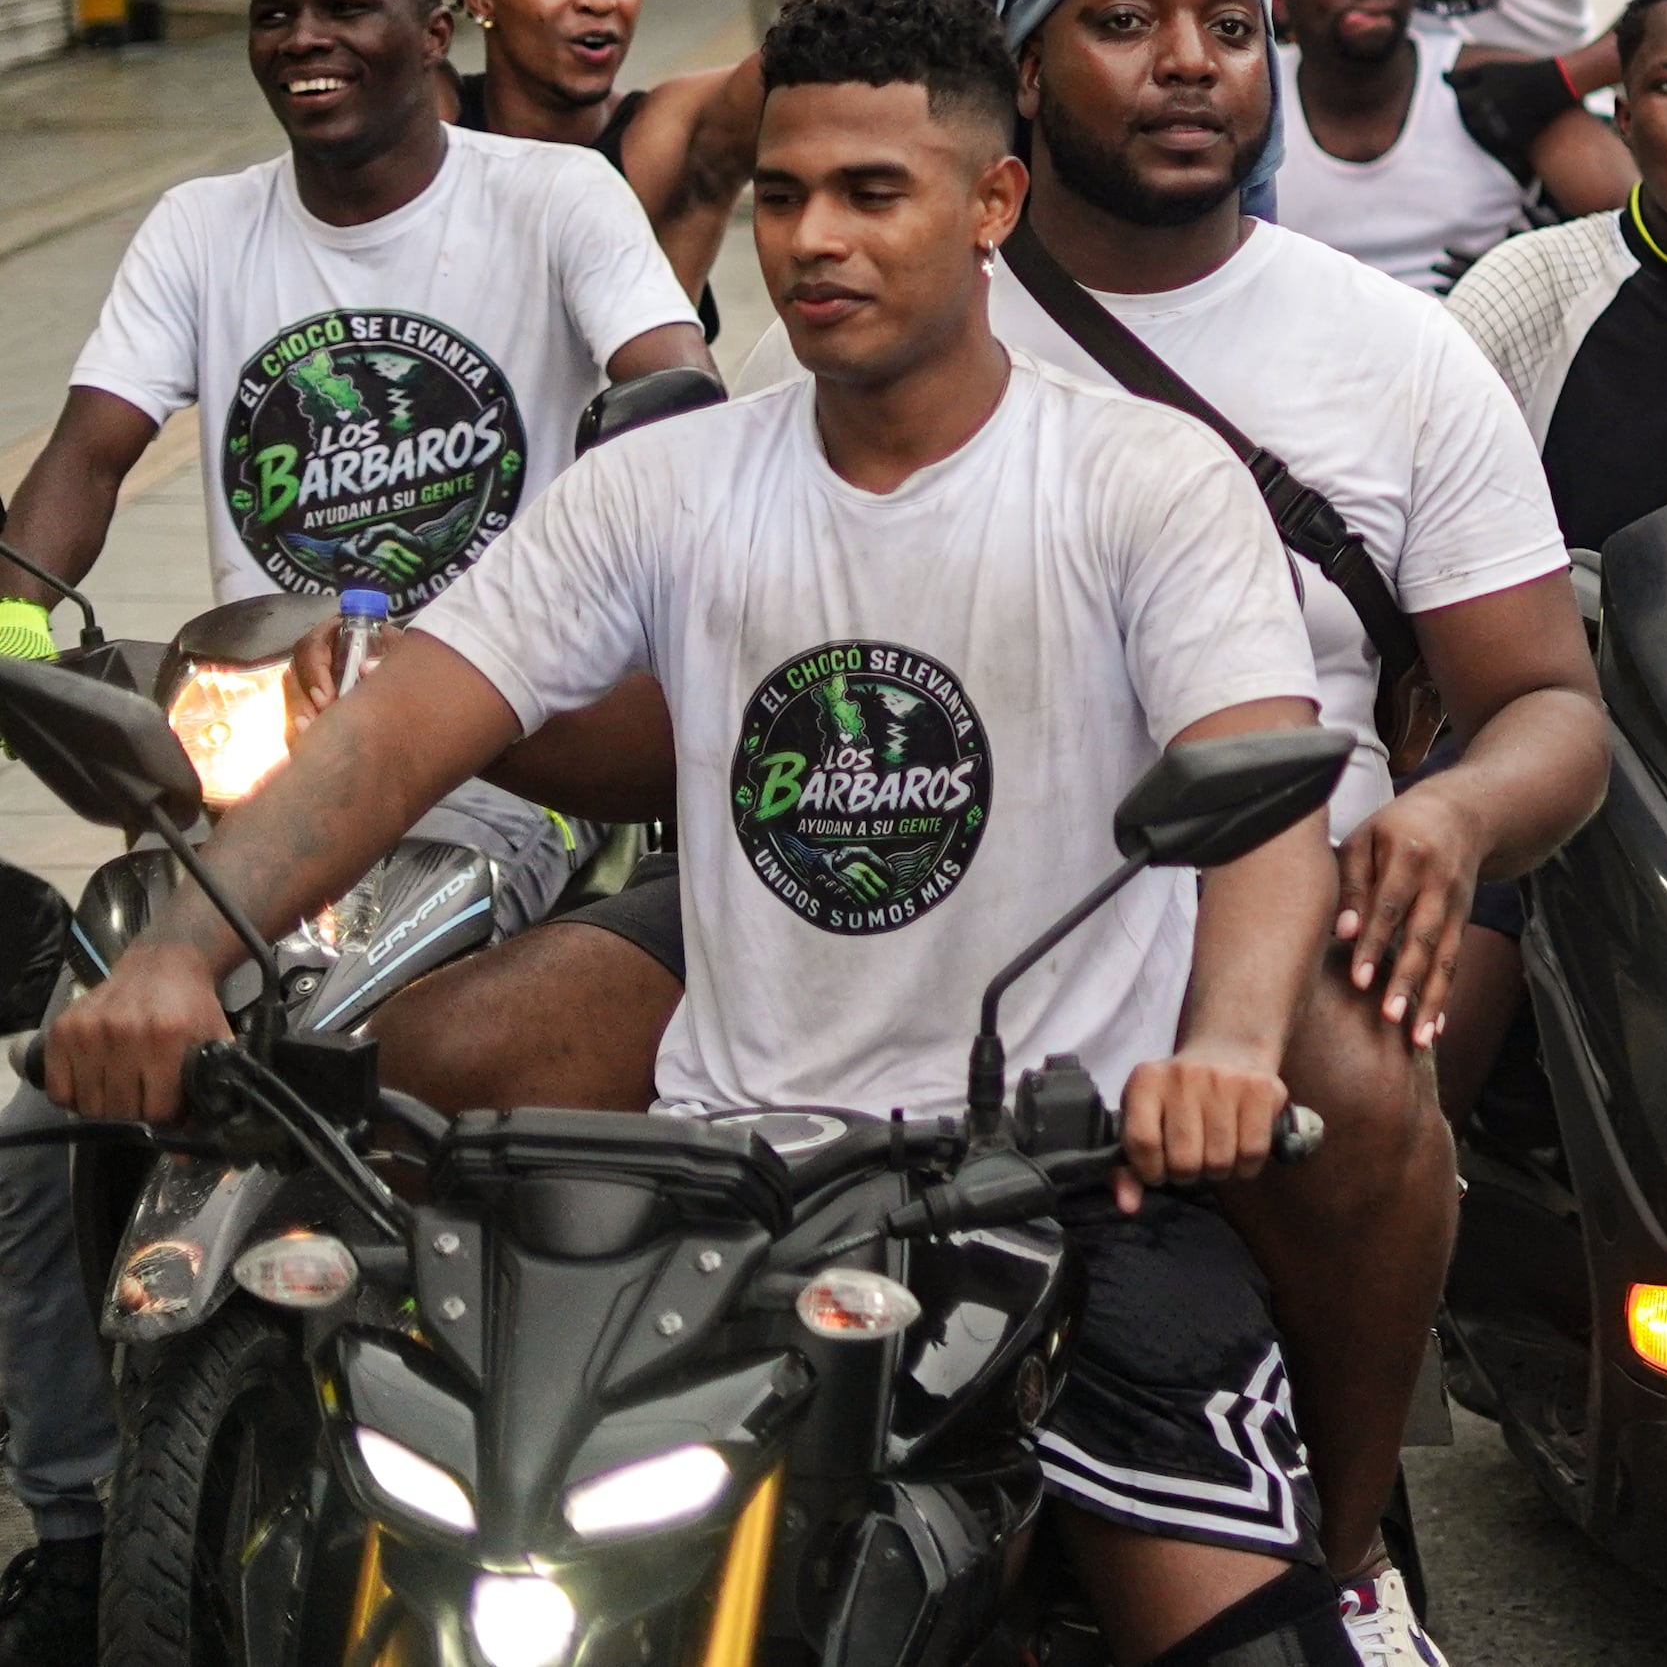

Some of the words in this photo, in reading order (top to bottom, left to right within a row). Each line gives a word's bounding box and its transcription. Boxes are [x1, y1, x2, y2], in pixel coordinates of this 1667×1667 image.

[239, 377, 267, 409] EL
[260, 314, 345, 378] CHOCÓ
[351, 316, 383, 341] SE
[390, 317, 490, 388] LEVANTA
[255, 406, 501, 525] BÁRBAROS
[318, 417, 380, 456] LOS
[303, 500, 372, 530] AYUDAN
[376, 495, 389, 513] A
[392, 489, 416, 510] SU
[419, 472, 476, 504] GENTE
[387, 563, 462, 613] UMOS
[760, 685, 788, 715] EL
[786, 643, 862, 690] CHOCÓ
[869, 649, 900, 673] SE
[901, 657, 974, 739] LEVANTA
[754, 751, 974, 823] BÁRBAROS
[824, 745, 875, 771] LOS
[797, 818, 853, 837] AYUDAN
[855, 819, 868, 836] A
[871, 818, 894, 835] SU
[898, 817, 943, 834] GENTE
[754, 848, 821, 918] UNIDOS
[829, 897, 916, 929] SUMOS
[920, 858, 961, 905] MÁS
